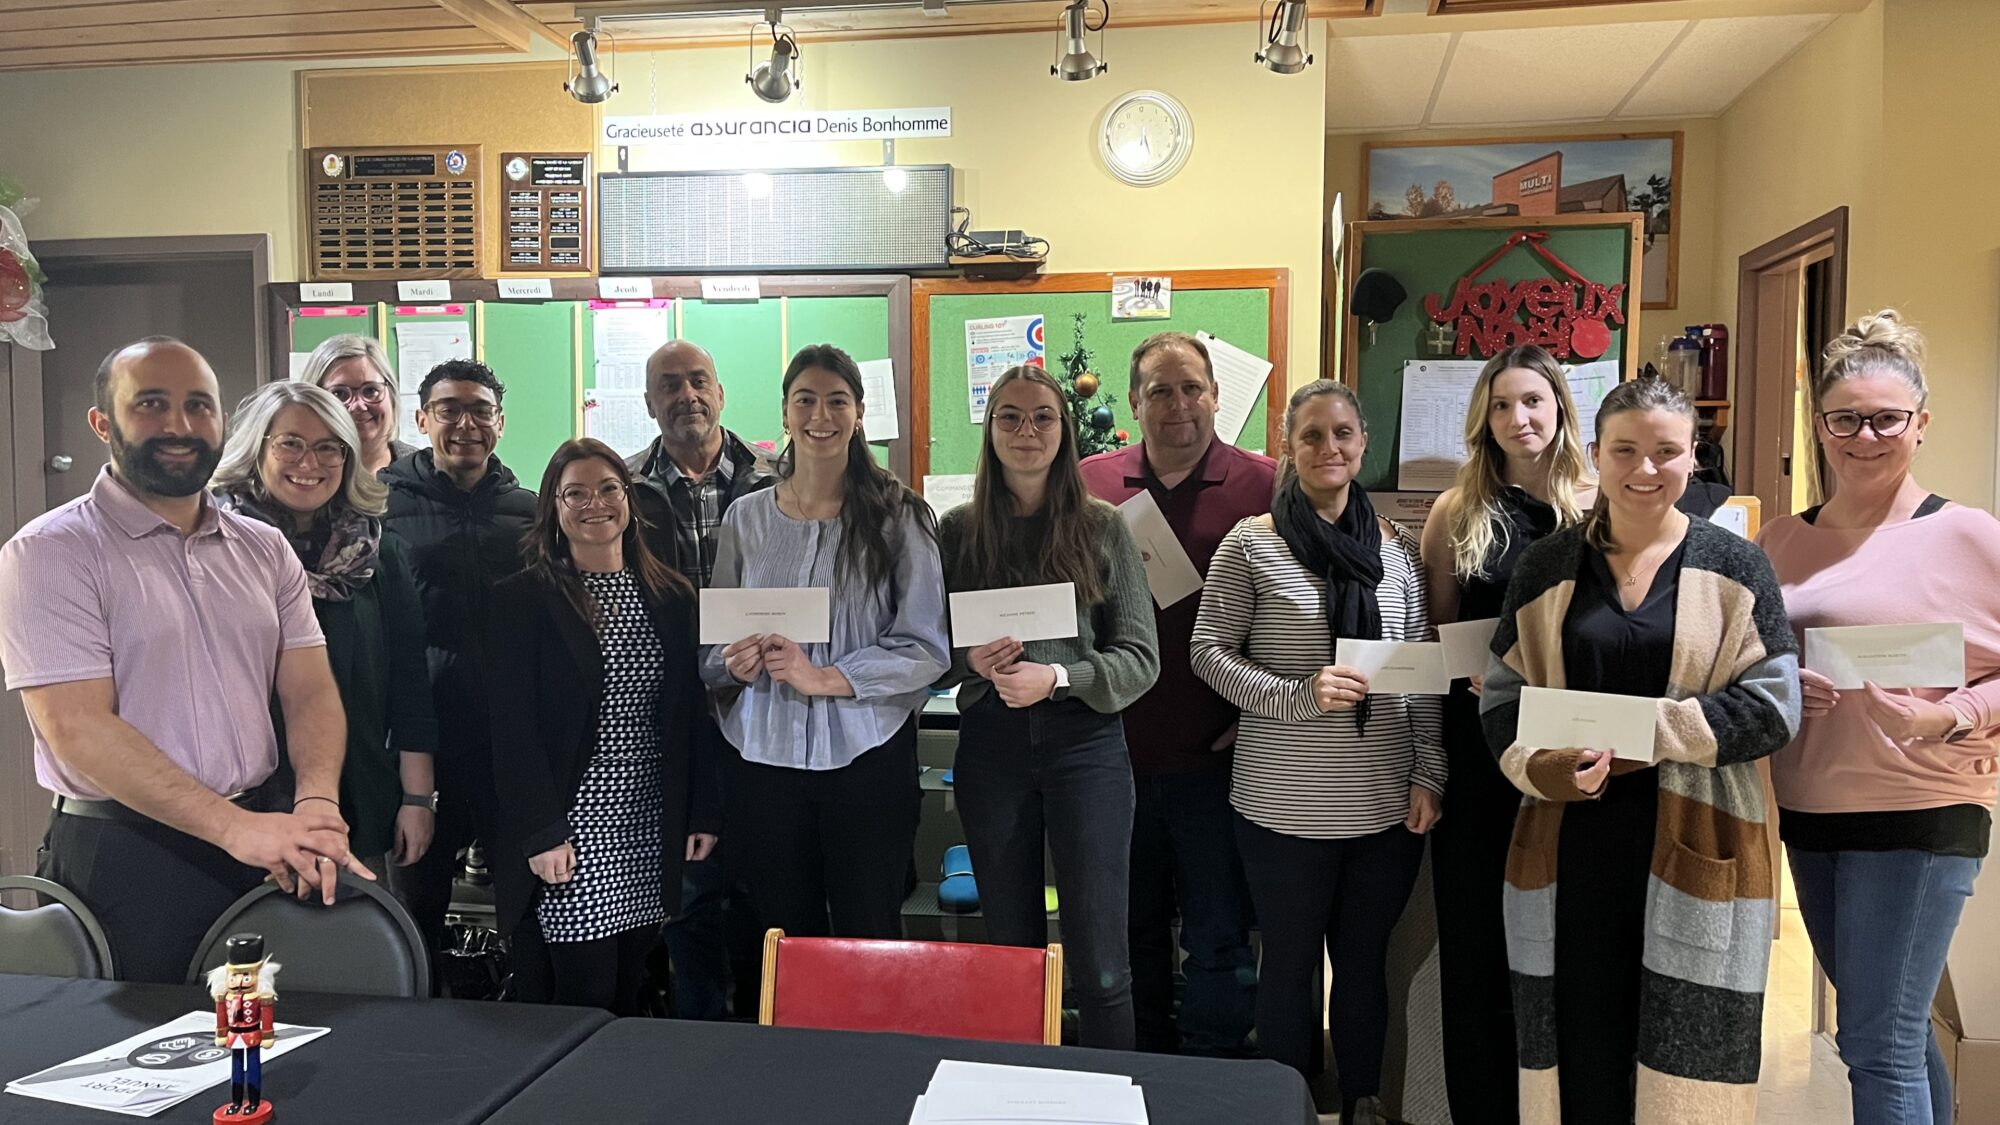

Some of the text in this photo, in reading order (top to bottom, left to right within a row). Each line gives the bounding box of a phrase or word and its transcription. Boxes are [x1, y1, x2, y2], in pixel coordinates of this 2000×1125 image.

[606, 115, 948, 139] Gracieuseté assurancia Denis Bonhomme
[1519, 174, 1552, 190] MULTI
[312, 289, 334, 298] Lundi
[410, 287, 434, 296] Mardi
[507, 286, 541, 295] Mercredi
[614, 285, 638, 293] Jeudi
[712, 285, 751, 293] Vendredi
[1424, 277, 1626, 324] Joyeux
[80, 1081, 140, 1095] PPORT
